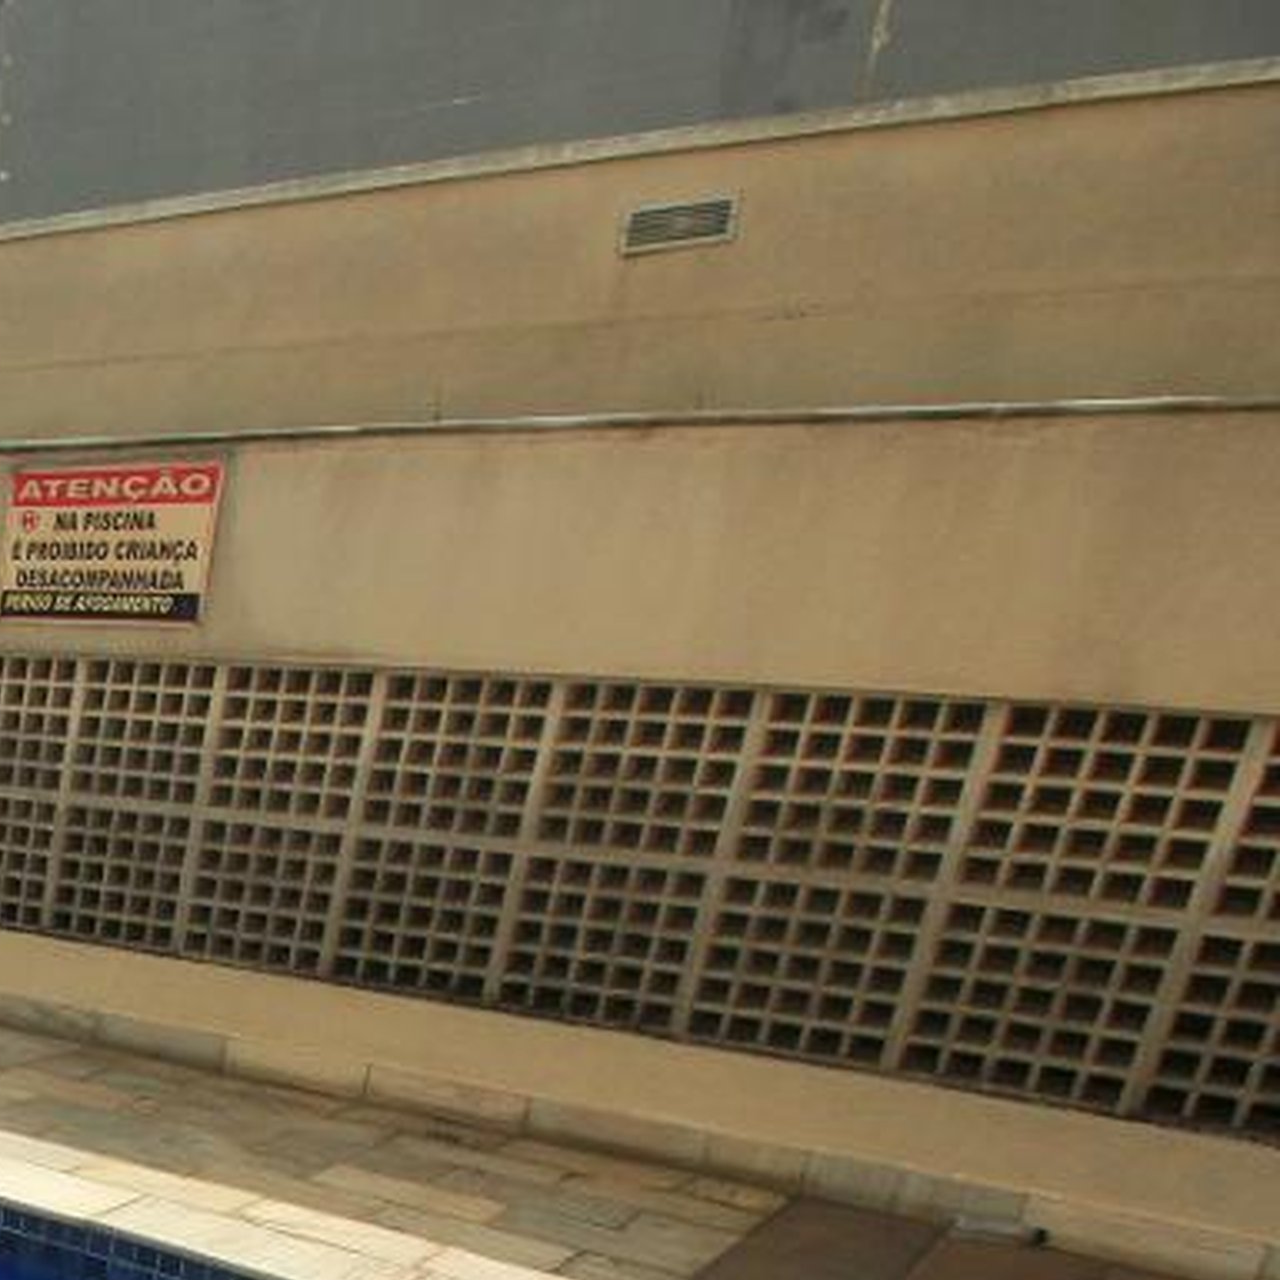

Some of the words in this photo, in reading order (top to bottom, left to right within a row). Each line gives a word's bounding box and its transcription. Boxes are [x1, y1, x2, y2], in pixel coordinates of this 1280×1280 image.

[18, 470, 210, 501] ATENÇÃO
[53, 512, 78, 531] NA
[83, 510, 156, 531] PISCINA
[26, 540, 109, 561] PROIBIDO
[113, 539, 198, 565] CRIANÇA
[16, 569, 184, 590] DESACOMPANHADA
